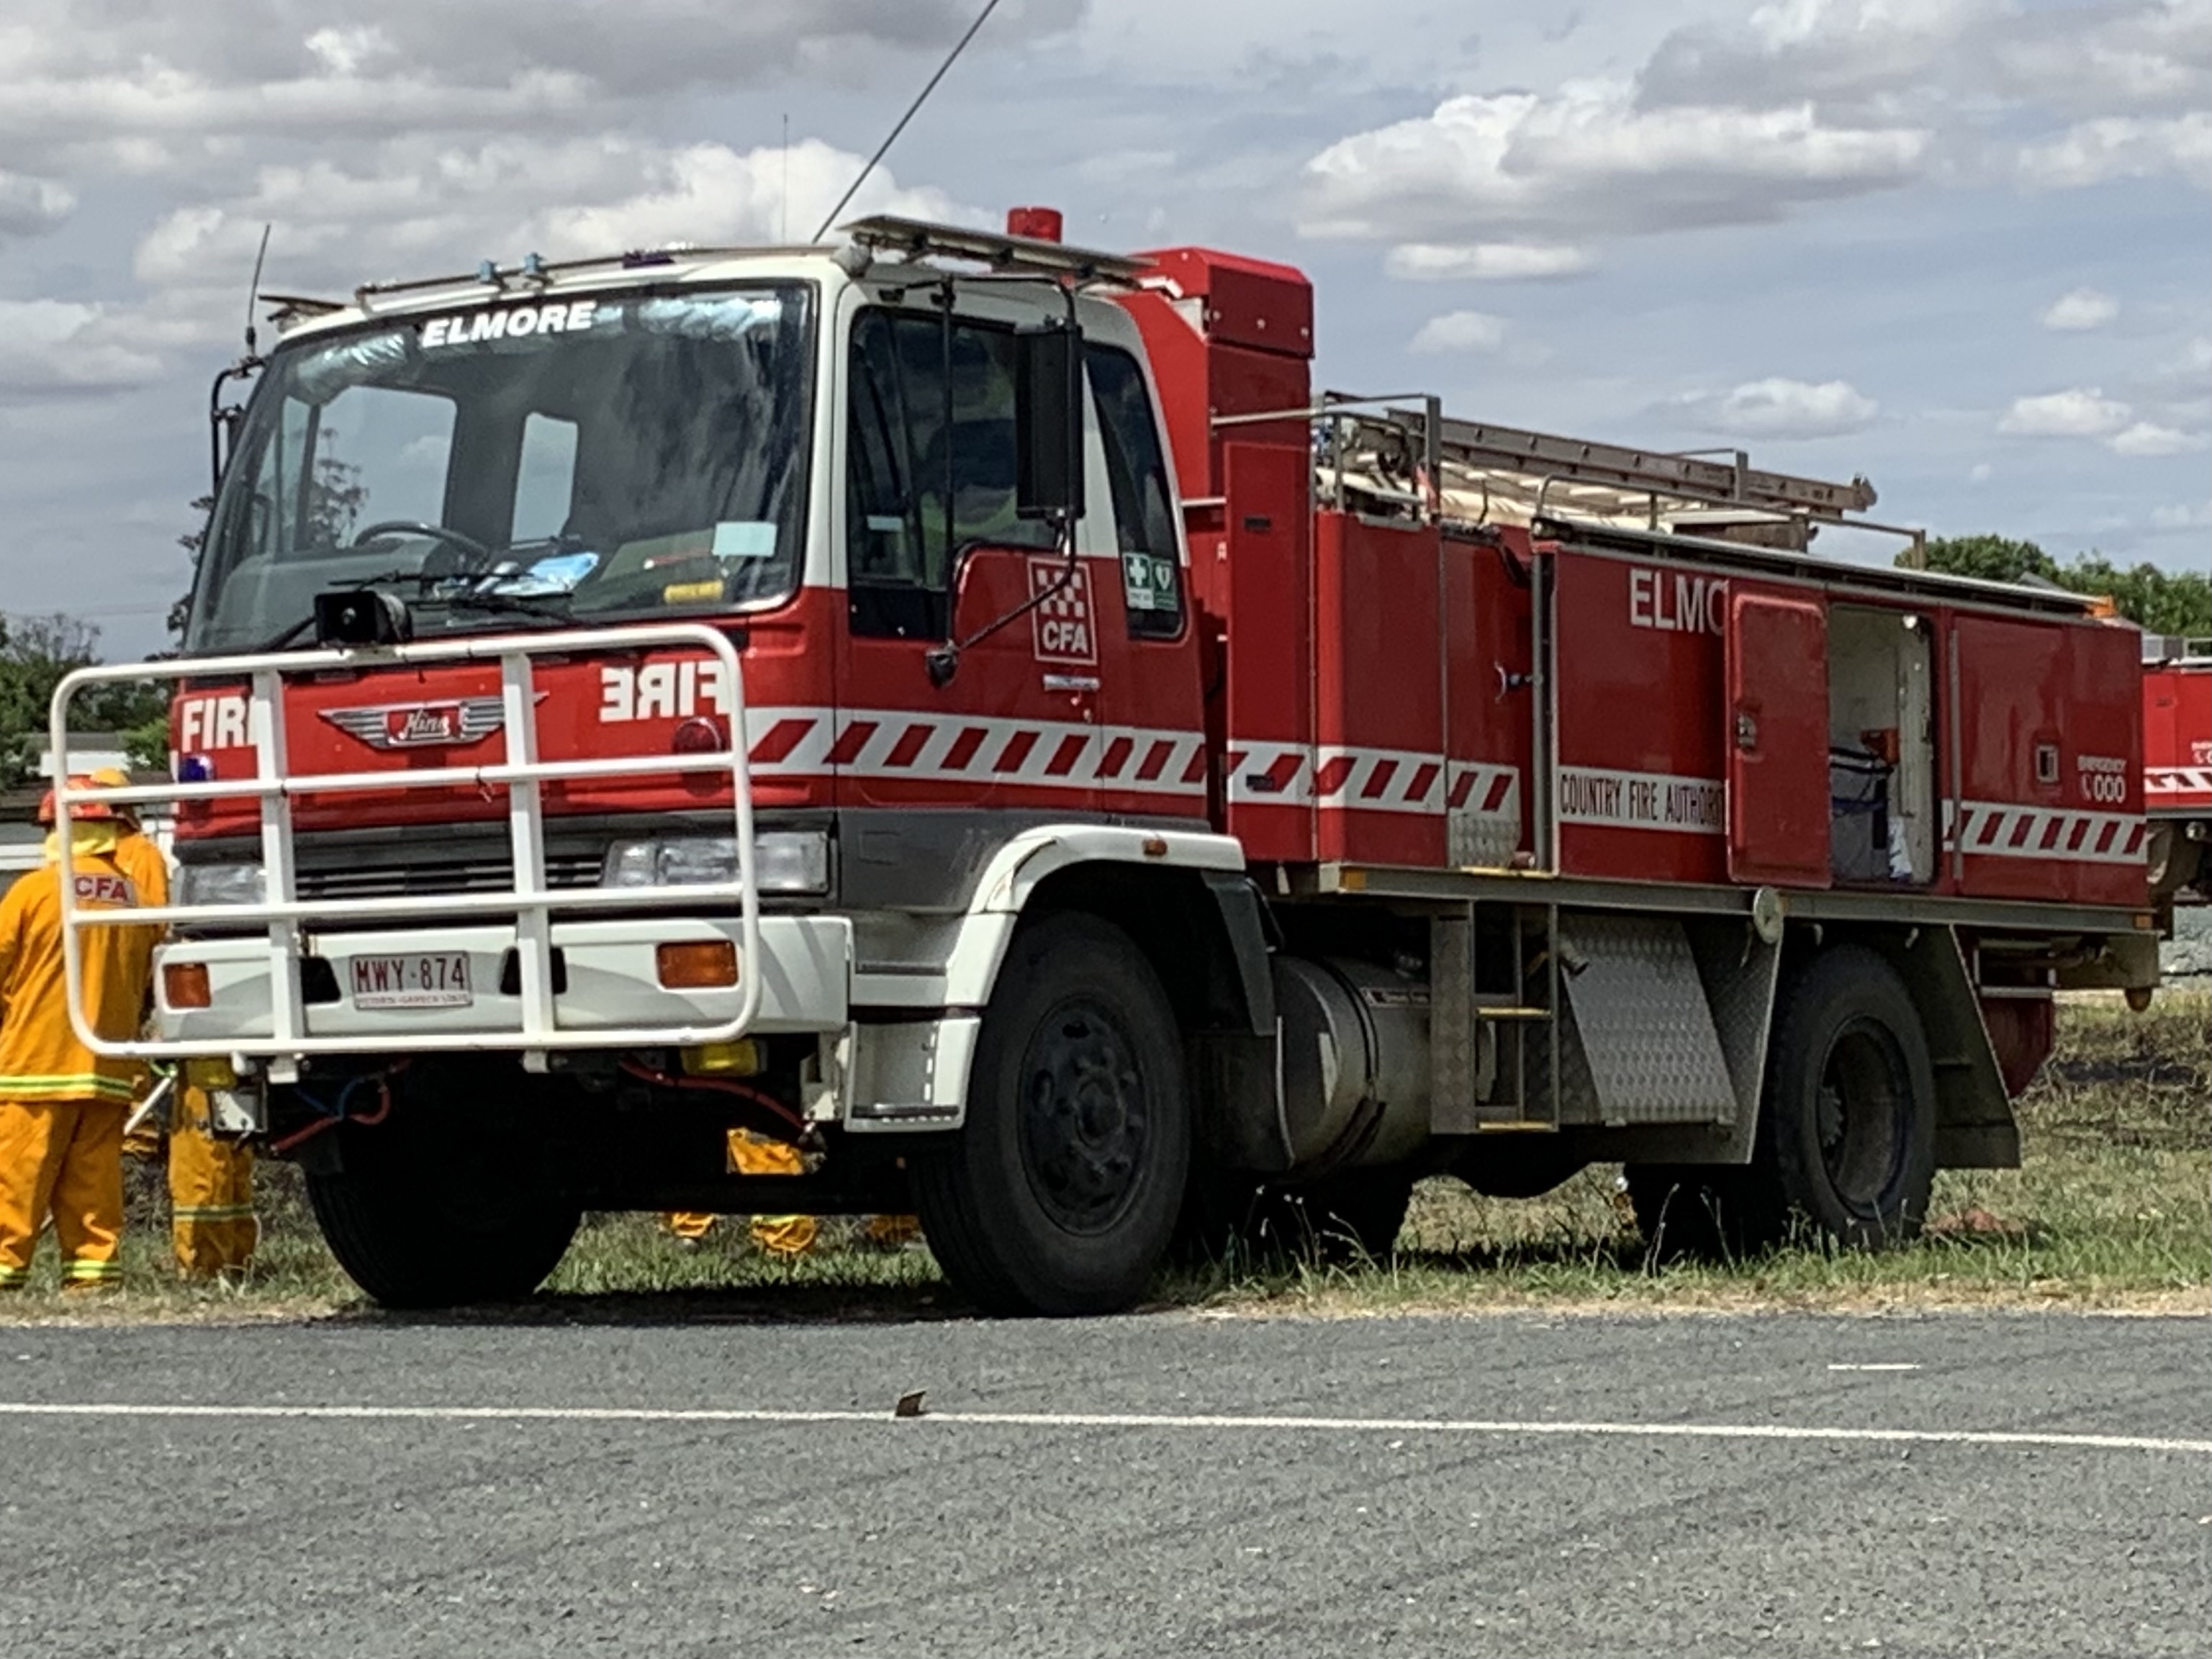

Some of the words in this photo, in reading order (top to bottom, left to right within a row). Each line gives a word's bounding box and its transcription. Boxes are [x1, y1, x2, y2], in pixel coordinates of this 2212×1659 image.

[422, 301, 597, 348] ELMORE
[1042, 620, 1088, 654] CFA
[1561, 774, 1621, 818] COUNTRY
[1630, 780, 1657, 820] FIRE
[2094, 774, 2126, 803] 000
[75, 877, 127, 900] CFA
